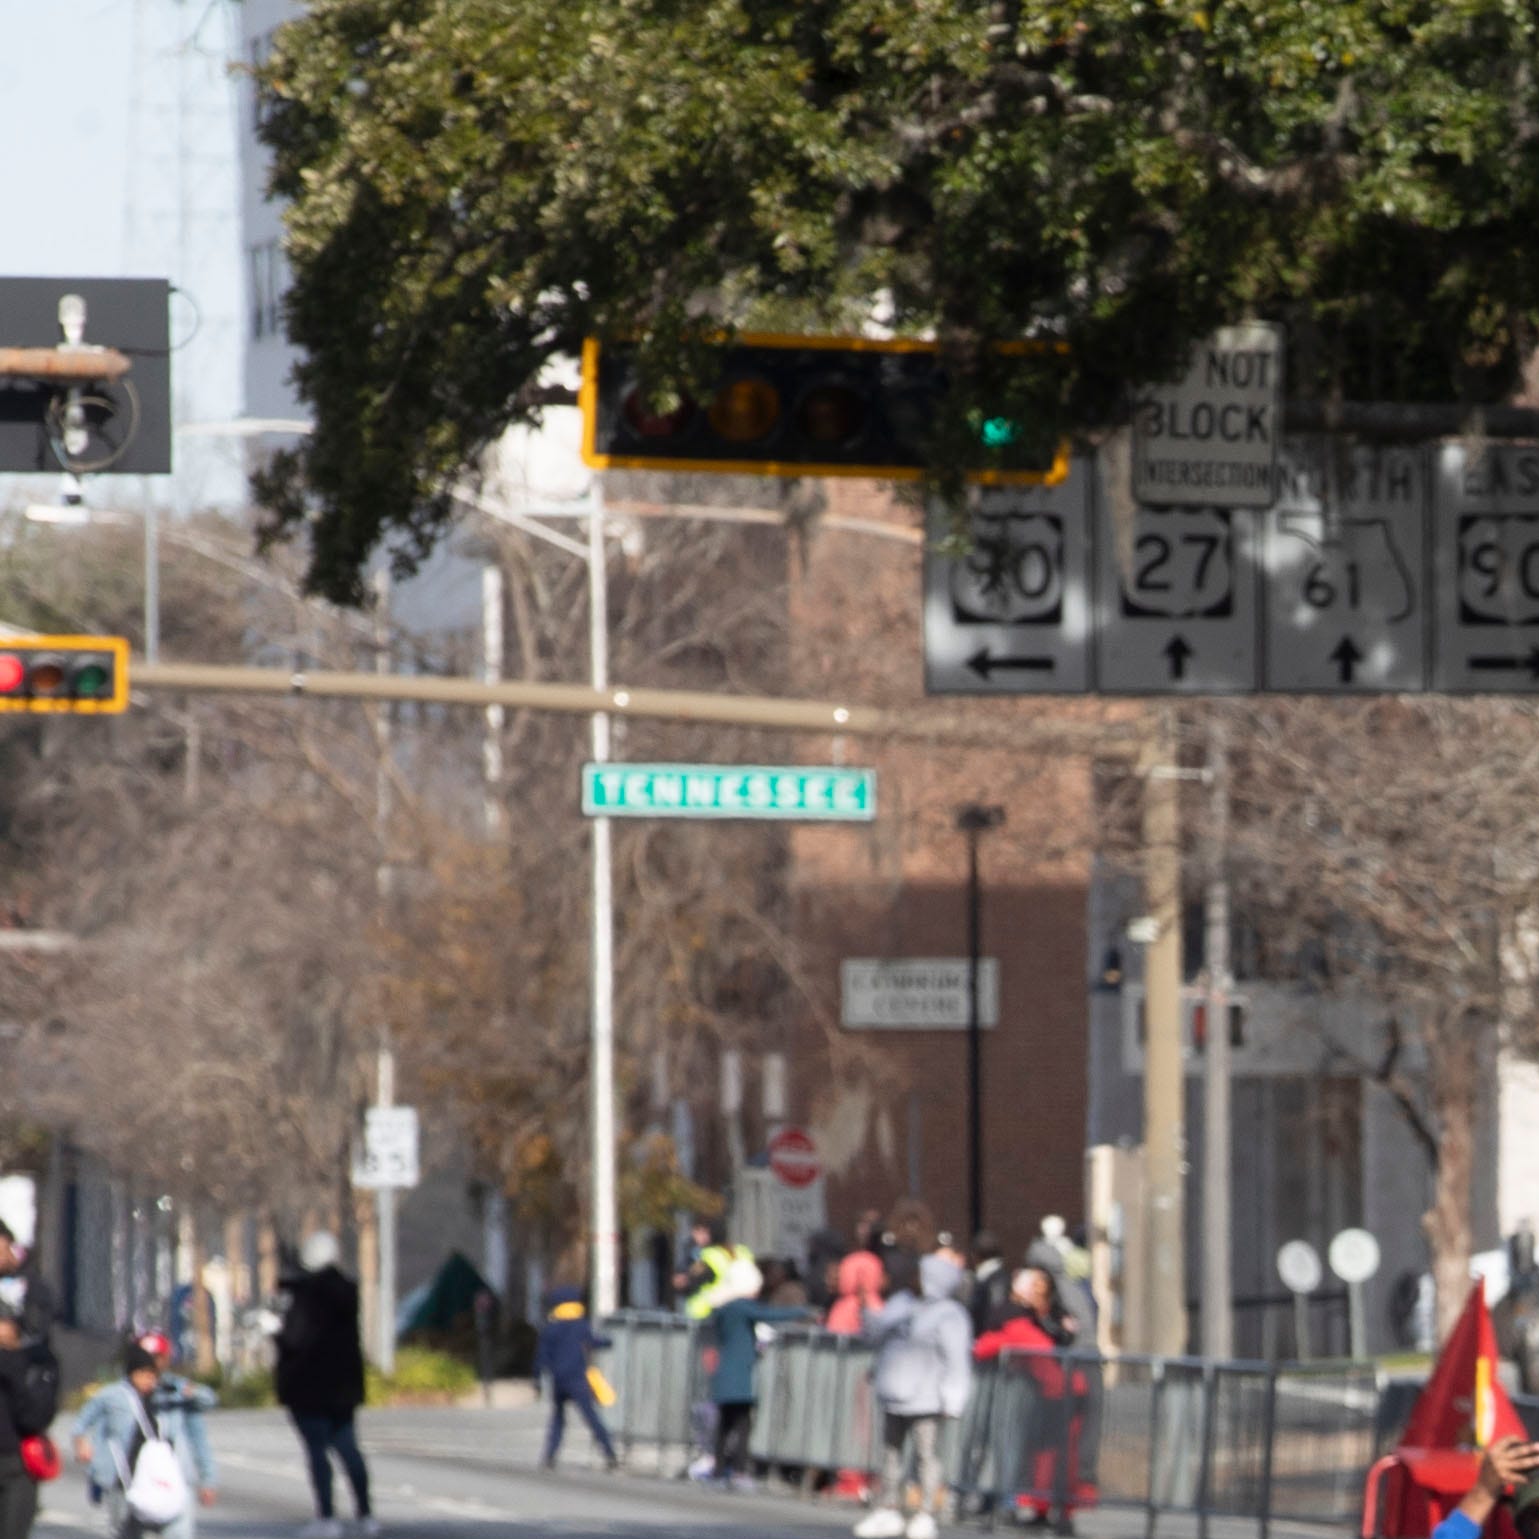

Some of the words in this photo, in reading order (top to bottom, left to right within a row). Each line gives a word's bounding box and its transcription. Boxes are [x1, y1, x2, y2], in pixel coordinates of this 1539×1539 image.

[1205, 351, 1271, 388] NOT
[1138, 401, 1269, 443] BLOCK
[1280, 458, 1412, 501] NRTH
[1135, 534, 1220, 593] 27
[1303, 562, 1361, 608] 61
[601, 774, 860, 809] TENNESSEE
